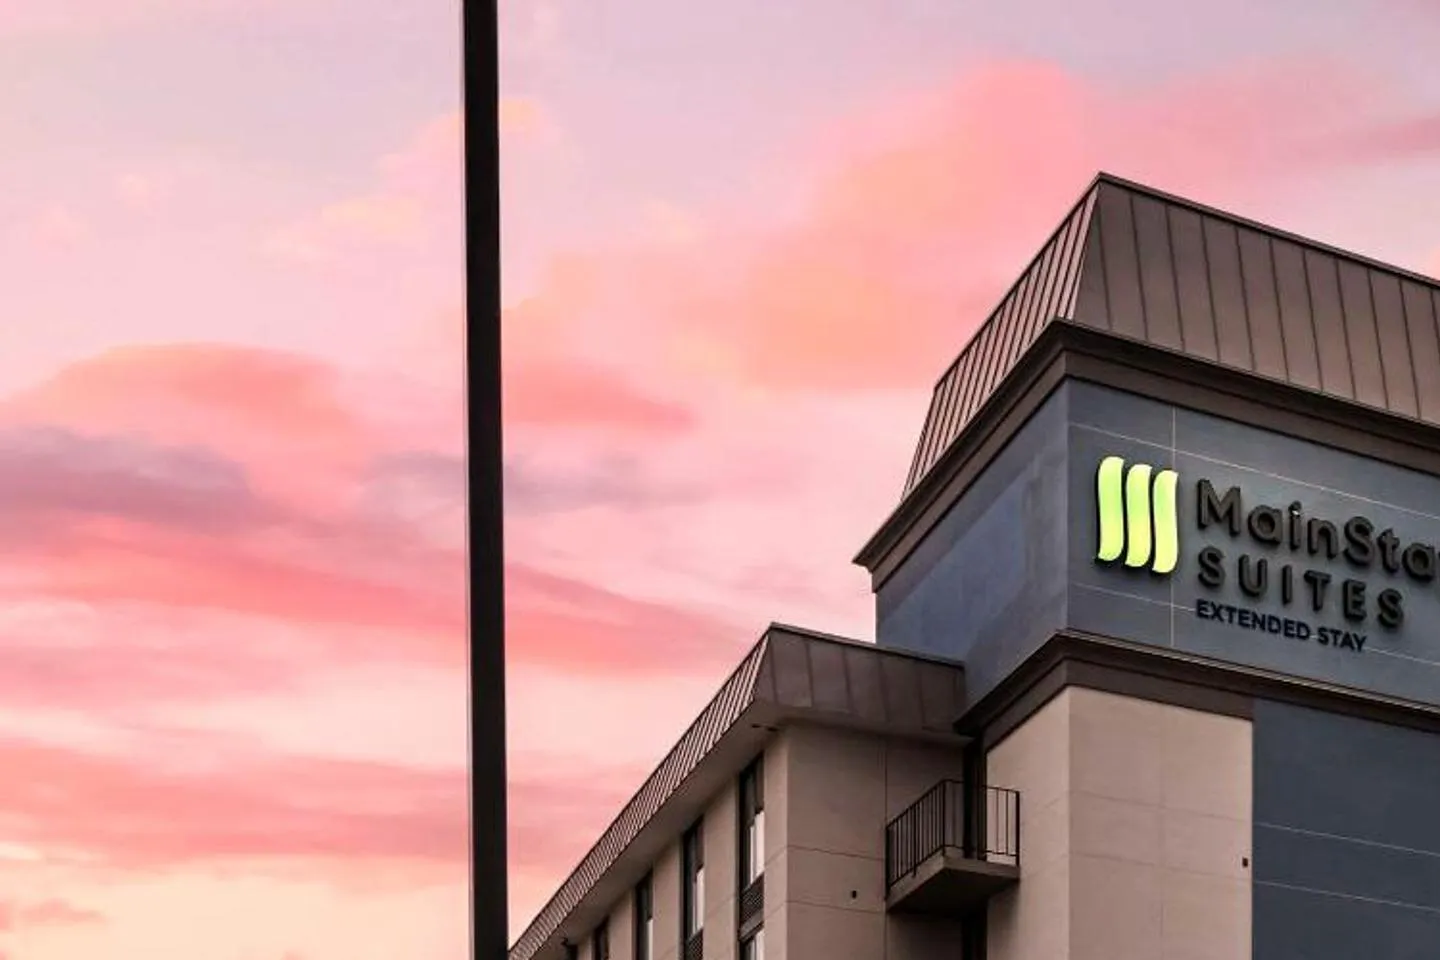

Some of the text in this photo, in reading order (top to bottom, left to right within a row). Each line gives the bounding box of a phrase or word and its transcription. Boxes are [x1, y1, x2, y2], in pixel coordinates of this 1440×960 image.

[1198, 546, 1404, 628] SUITES
[1196, 599, 1368, 652] EXTENDED STAY
